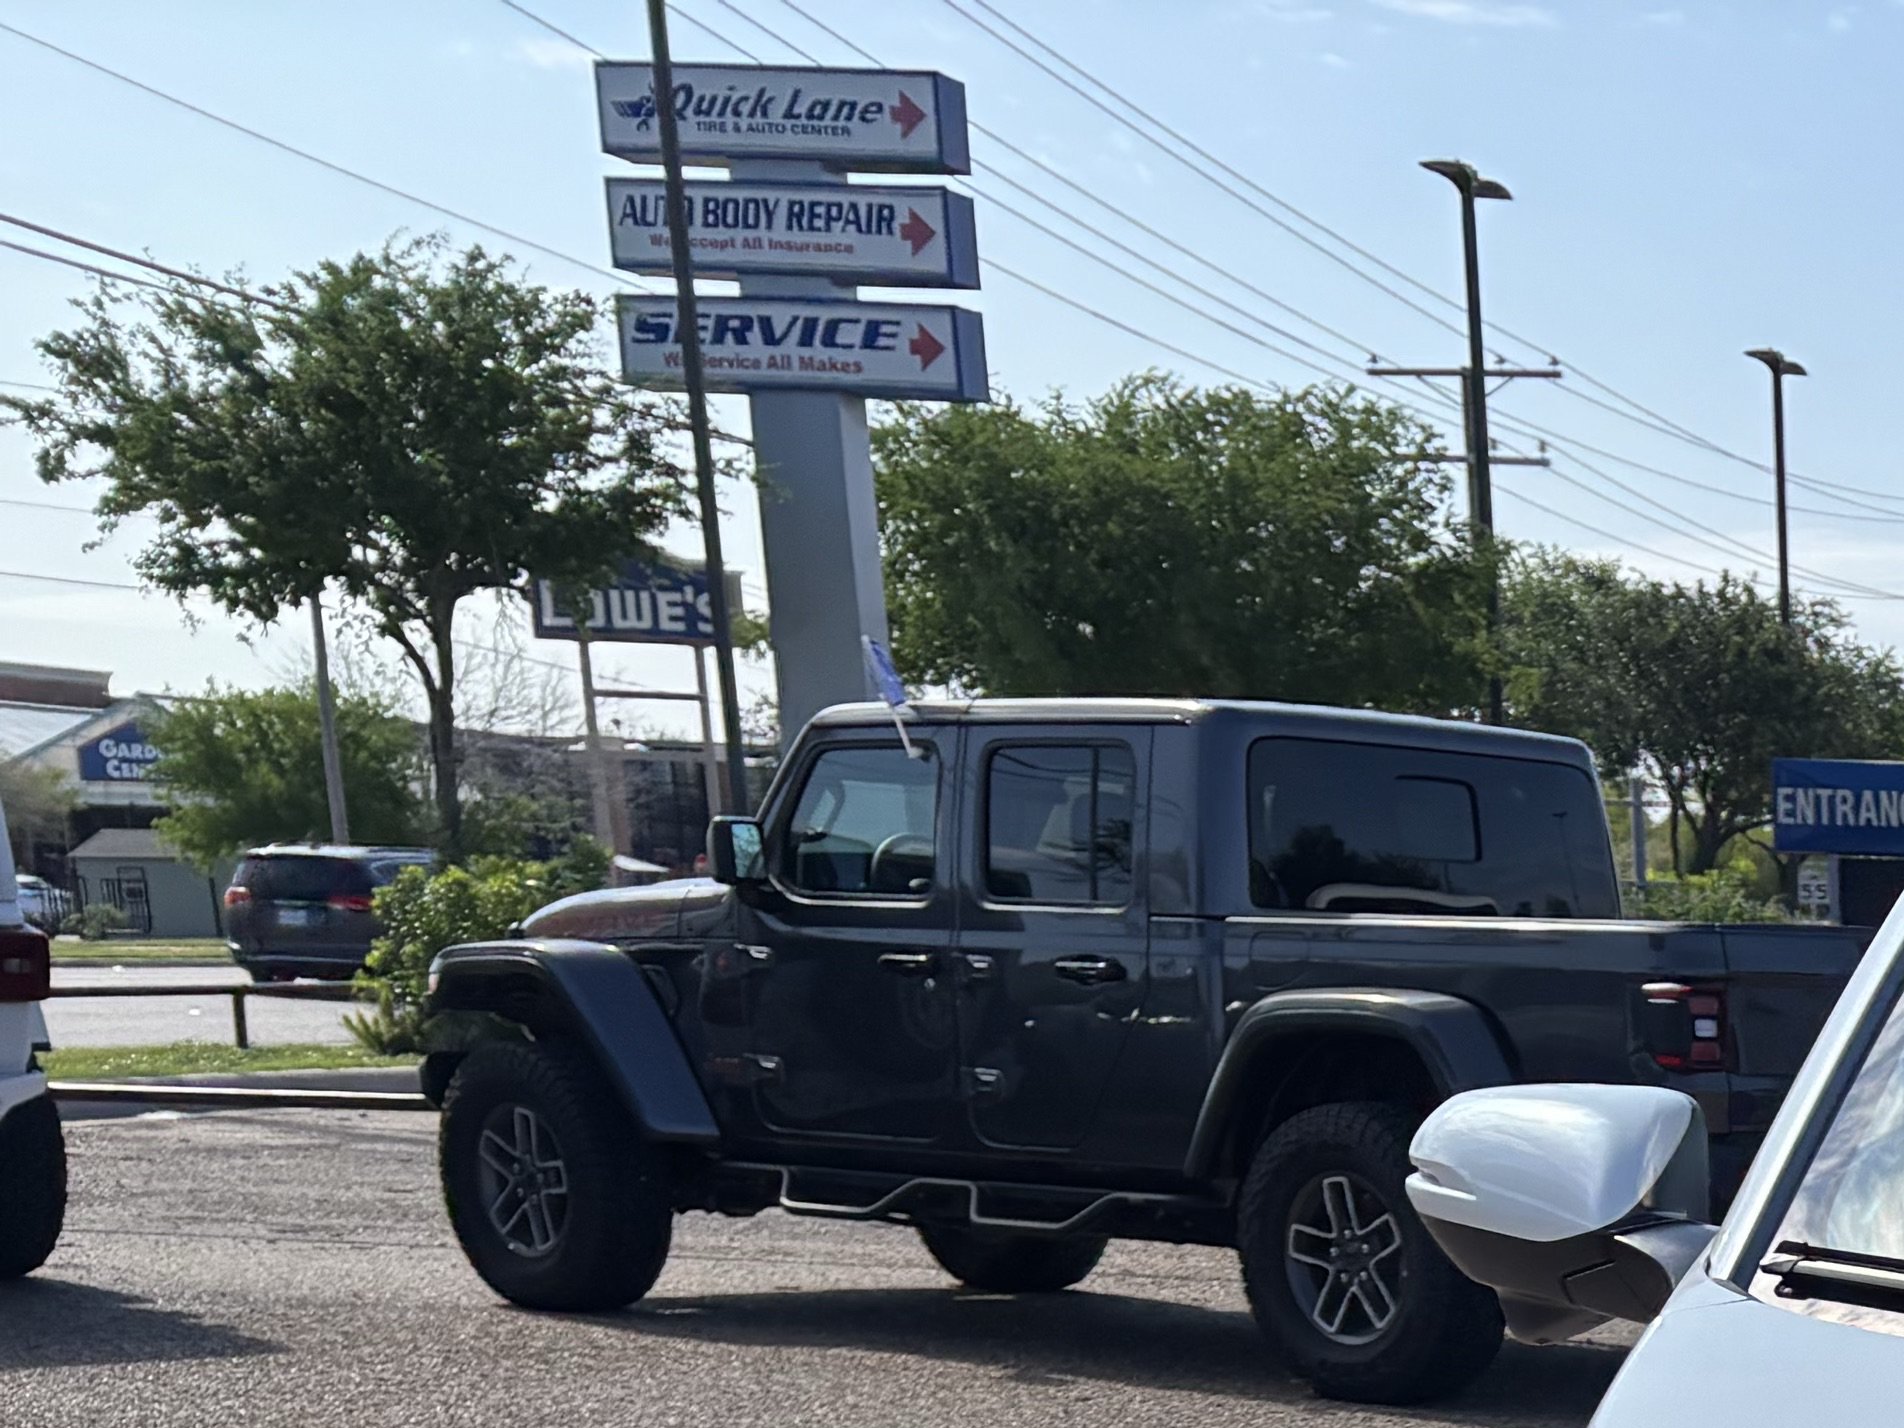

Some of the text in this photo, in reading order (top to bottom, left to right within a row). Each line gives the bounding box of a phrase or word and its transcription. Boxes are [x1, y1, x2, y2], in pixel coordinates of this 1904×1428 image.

[669, 83, 884, 124] Quick Lane
[696, 121, 851, 137] TIRE & AUTO CENTER
[701, 196, 780, 231] BODY
[785, 199, 896, 236] REPAIR
[688, 236, 737, 250] ccept
[768, 237, 855, 255] Insurance
[632, 312, 902, 350] SERVICE
[766, 354, 792, 371] All
[798, 356, 864, 374] Makes
